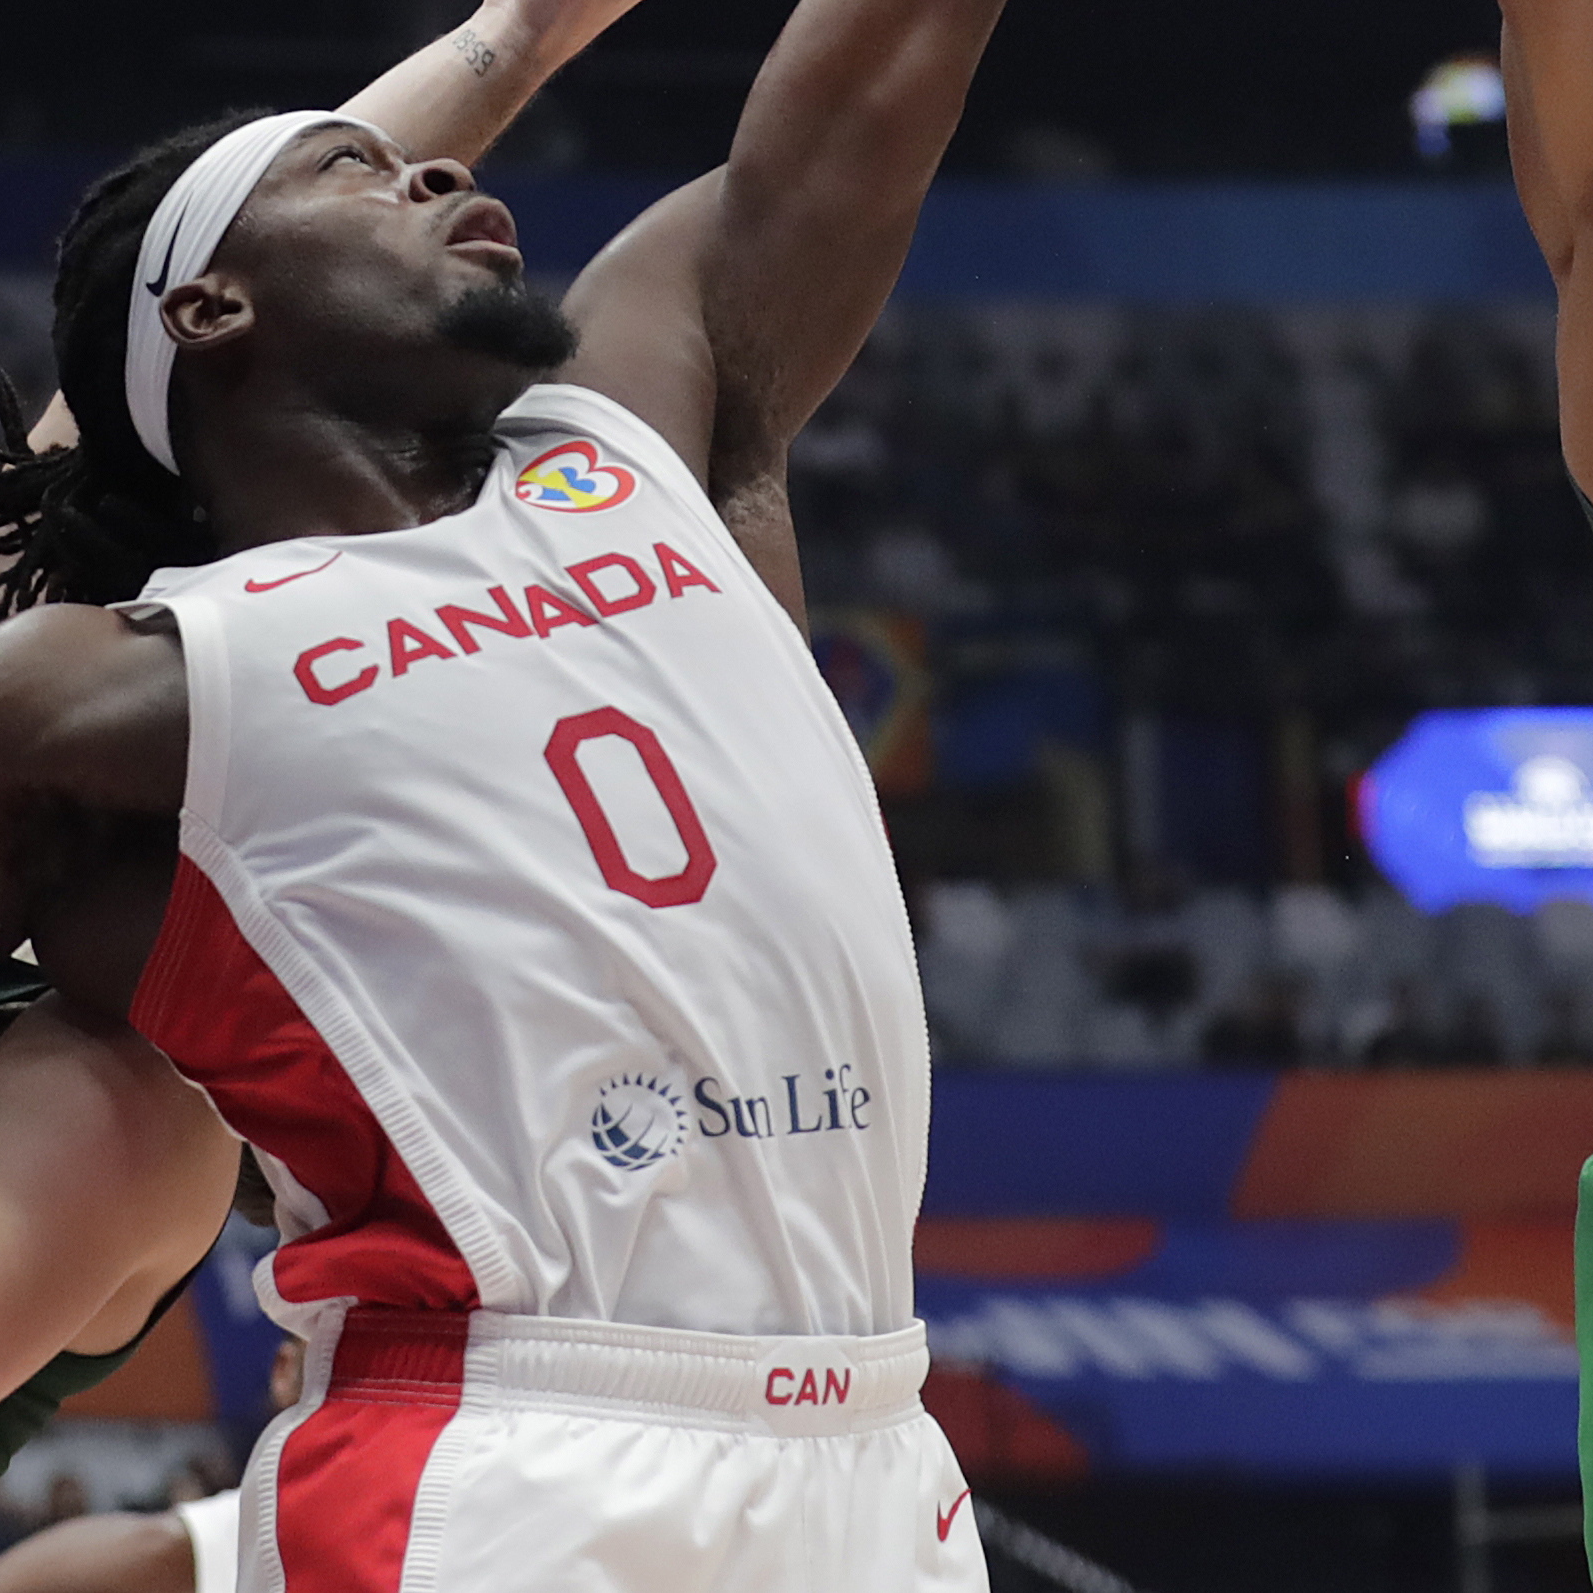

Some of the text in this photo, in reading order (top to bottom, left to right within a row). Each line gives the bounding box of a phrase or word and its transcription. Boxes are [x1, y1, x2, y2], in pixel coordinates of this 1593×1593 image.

[293, 542, 722, 706] CANADA
[543, 705, 717, 909] 0
[693, 1063, 871, 1139] Sun Life
[765, 1367, 851, 1405] CAN
